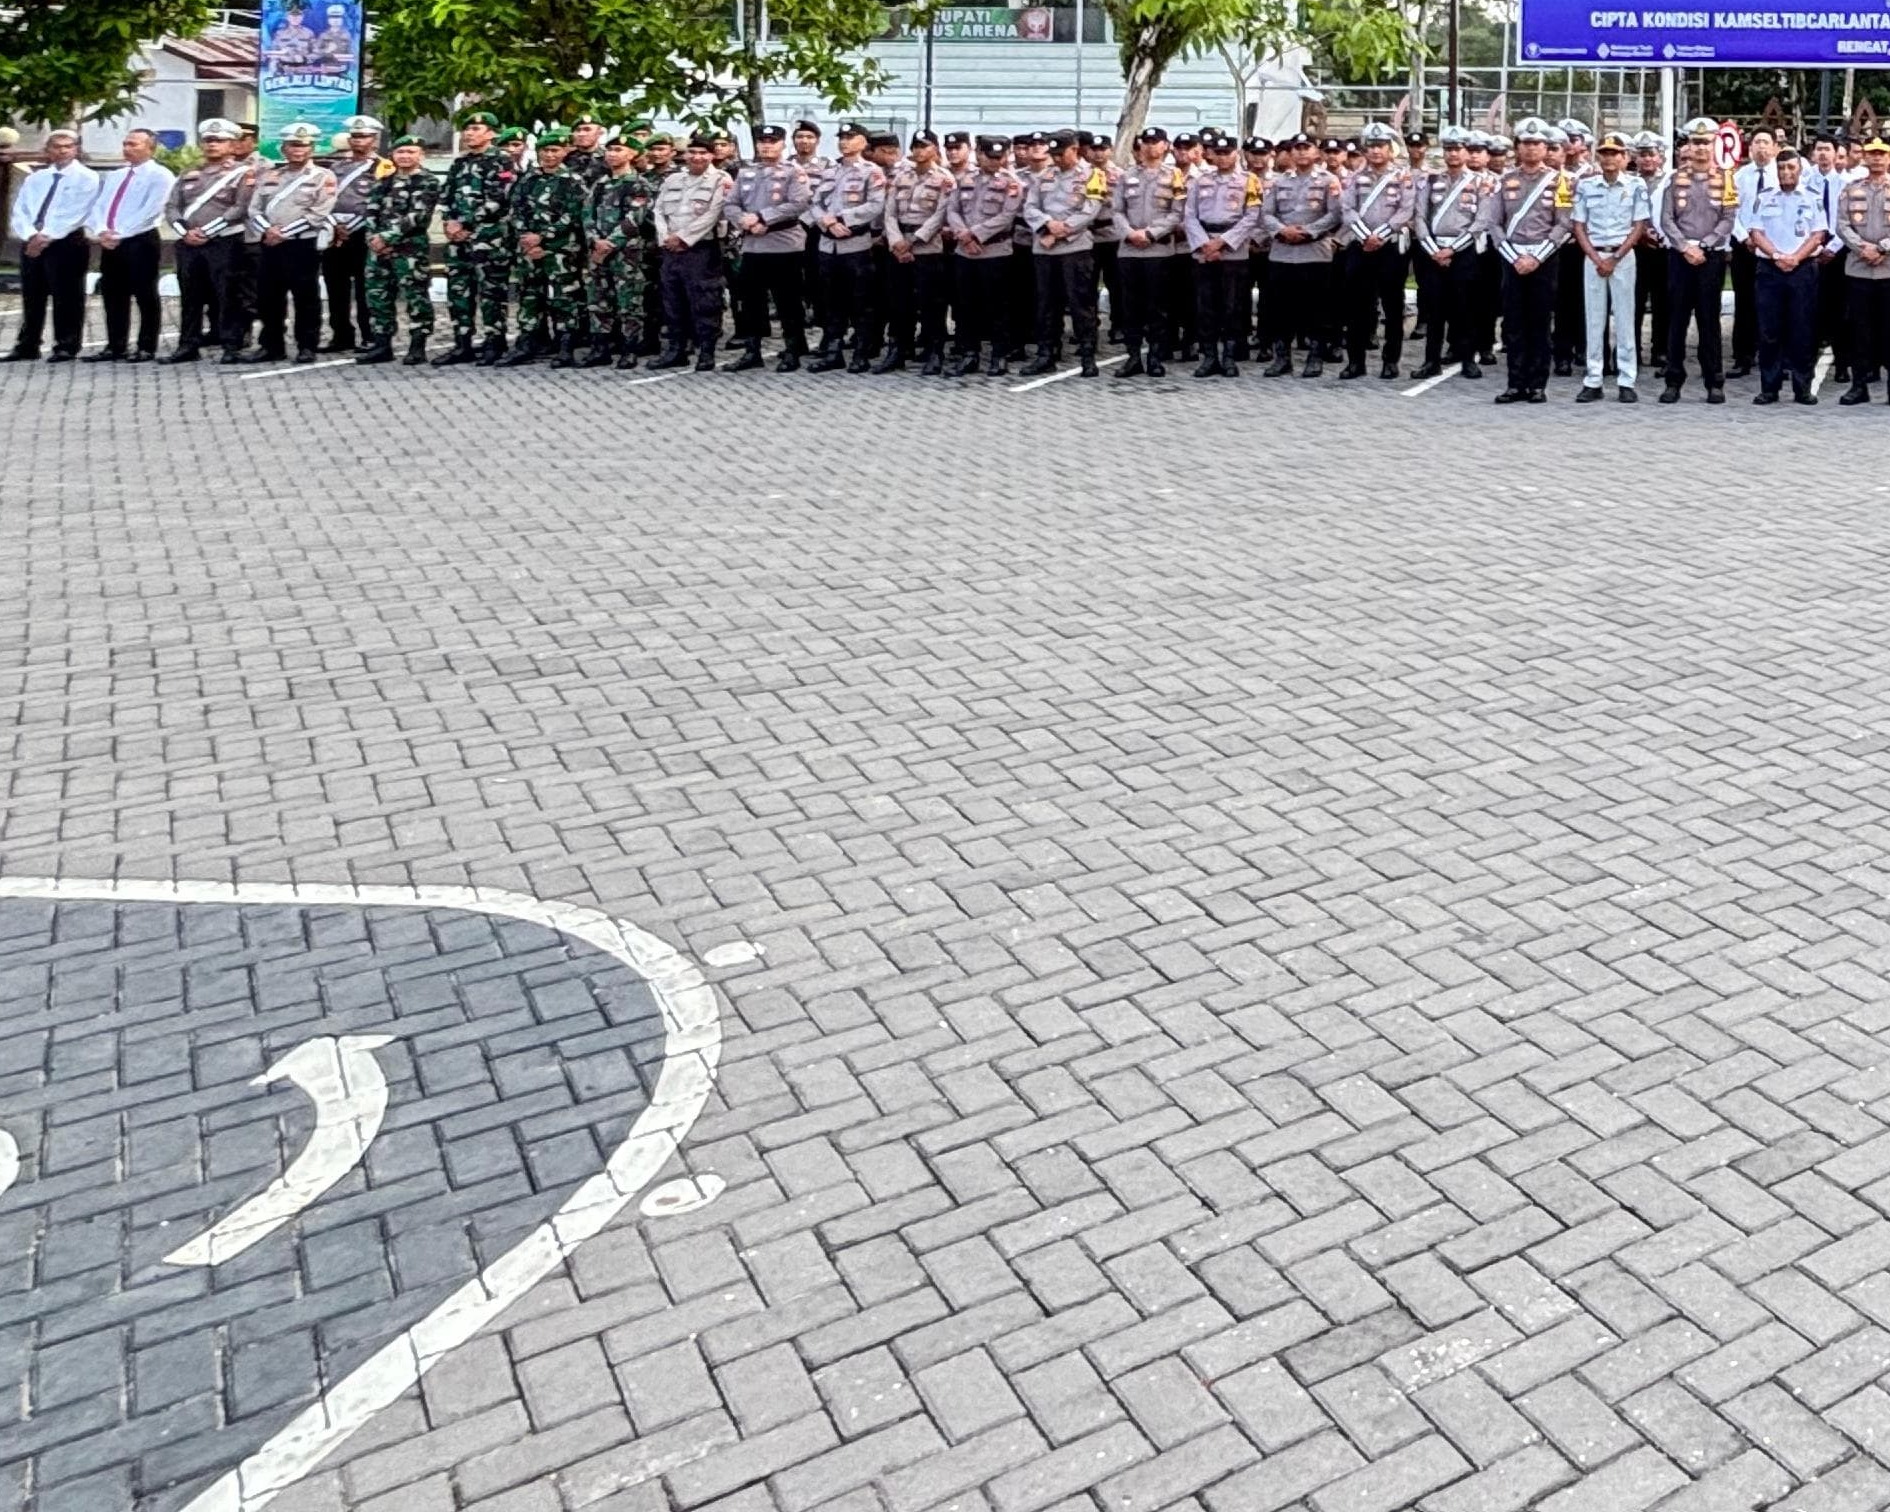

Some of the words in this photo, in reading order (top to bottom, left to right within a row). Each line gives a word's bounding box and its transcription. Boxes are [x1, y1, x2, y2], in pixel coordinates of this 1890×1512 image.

[1590, 11, 1638, 28] CIPTA
[1643, 12, 1709, 29] KONDISI
[961, 24, 1018, 37] ARENA
